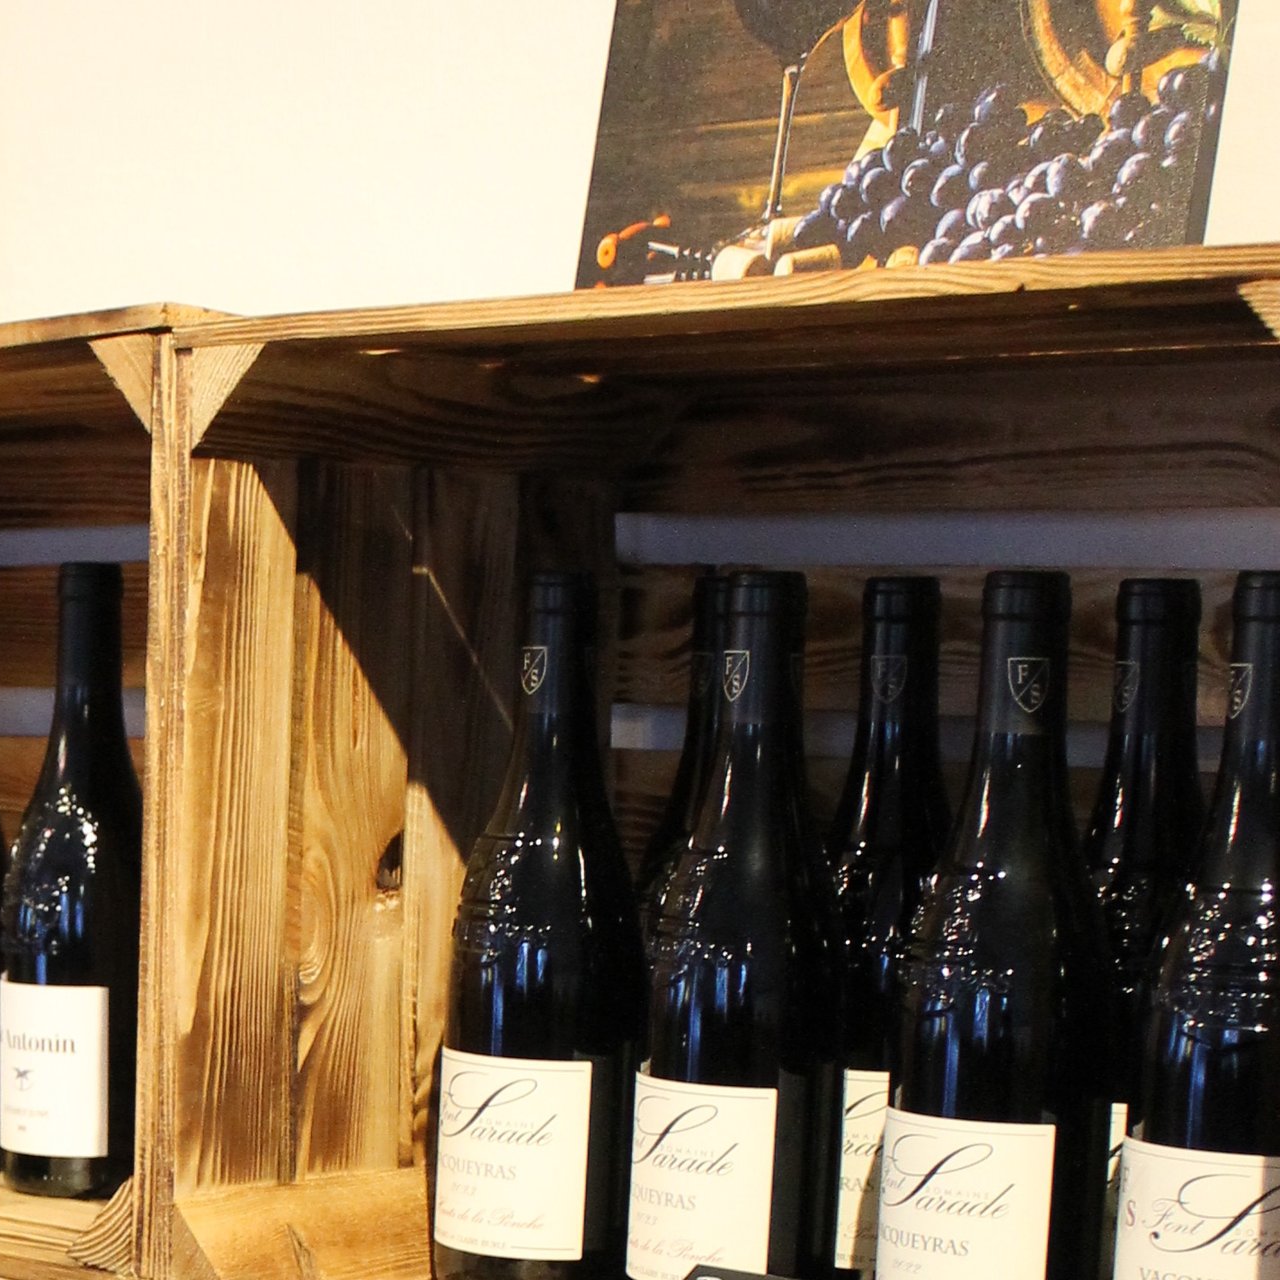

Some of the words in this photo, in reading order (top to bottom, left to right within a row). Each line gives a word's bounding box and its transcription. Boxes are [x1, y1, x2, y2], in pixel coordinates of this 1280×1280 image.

[4, 1027, 78, 1055] Antonin
[439, 1152, 518, 1181] CQUEYRAS
[632, 1183, 697, 1211] QUEYRAS
[880, 1225, 970, 1257] CQUEYRAS
